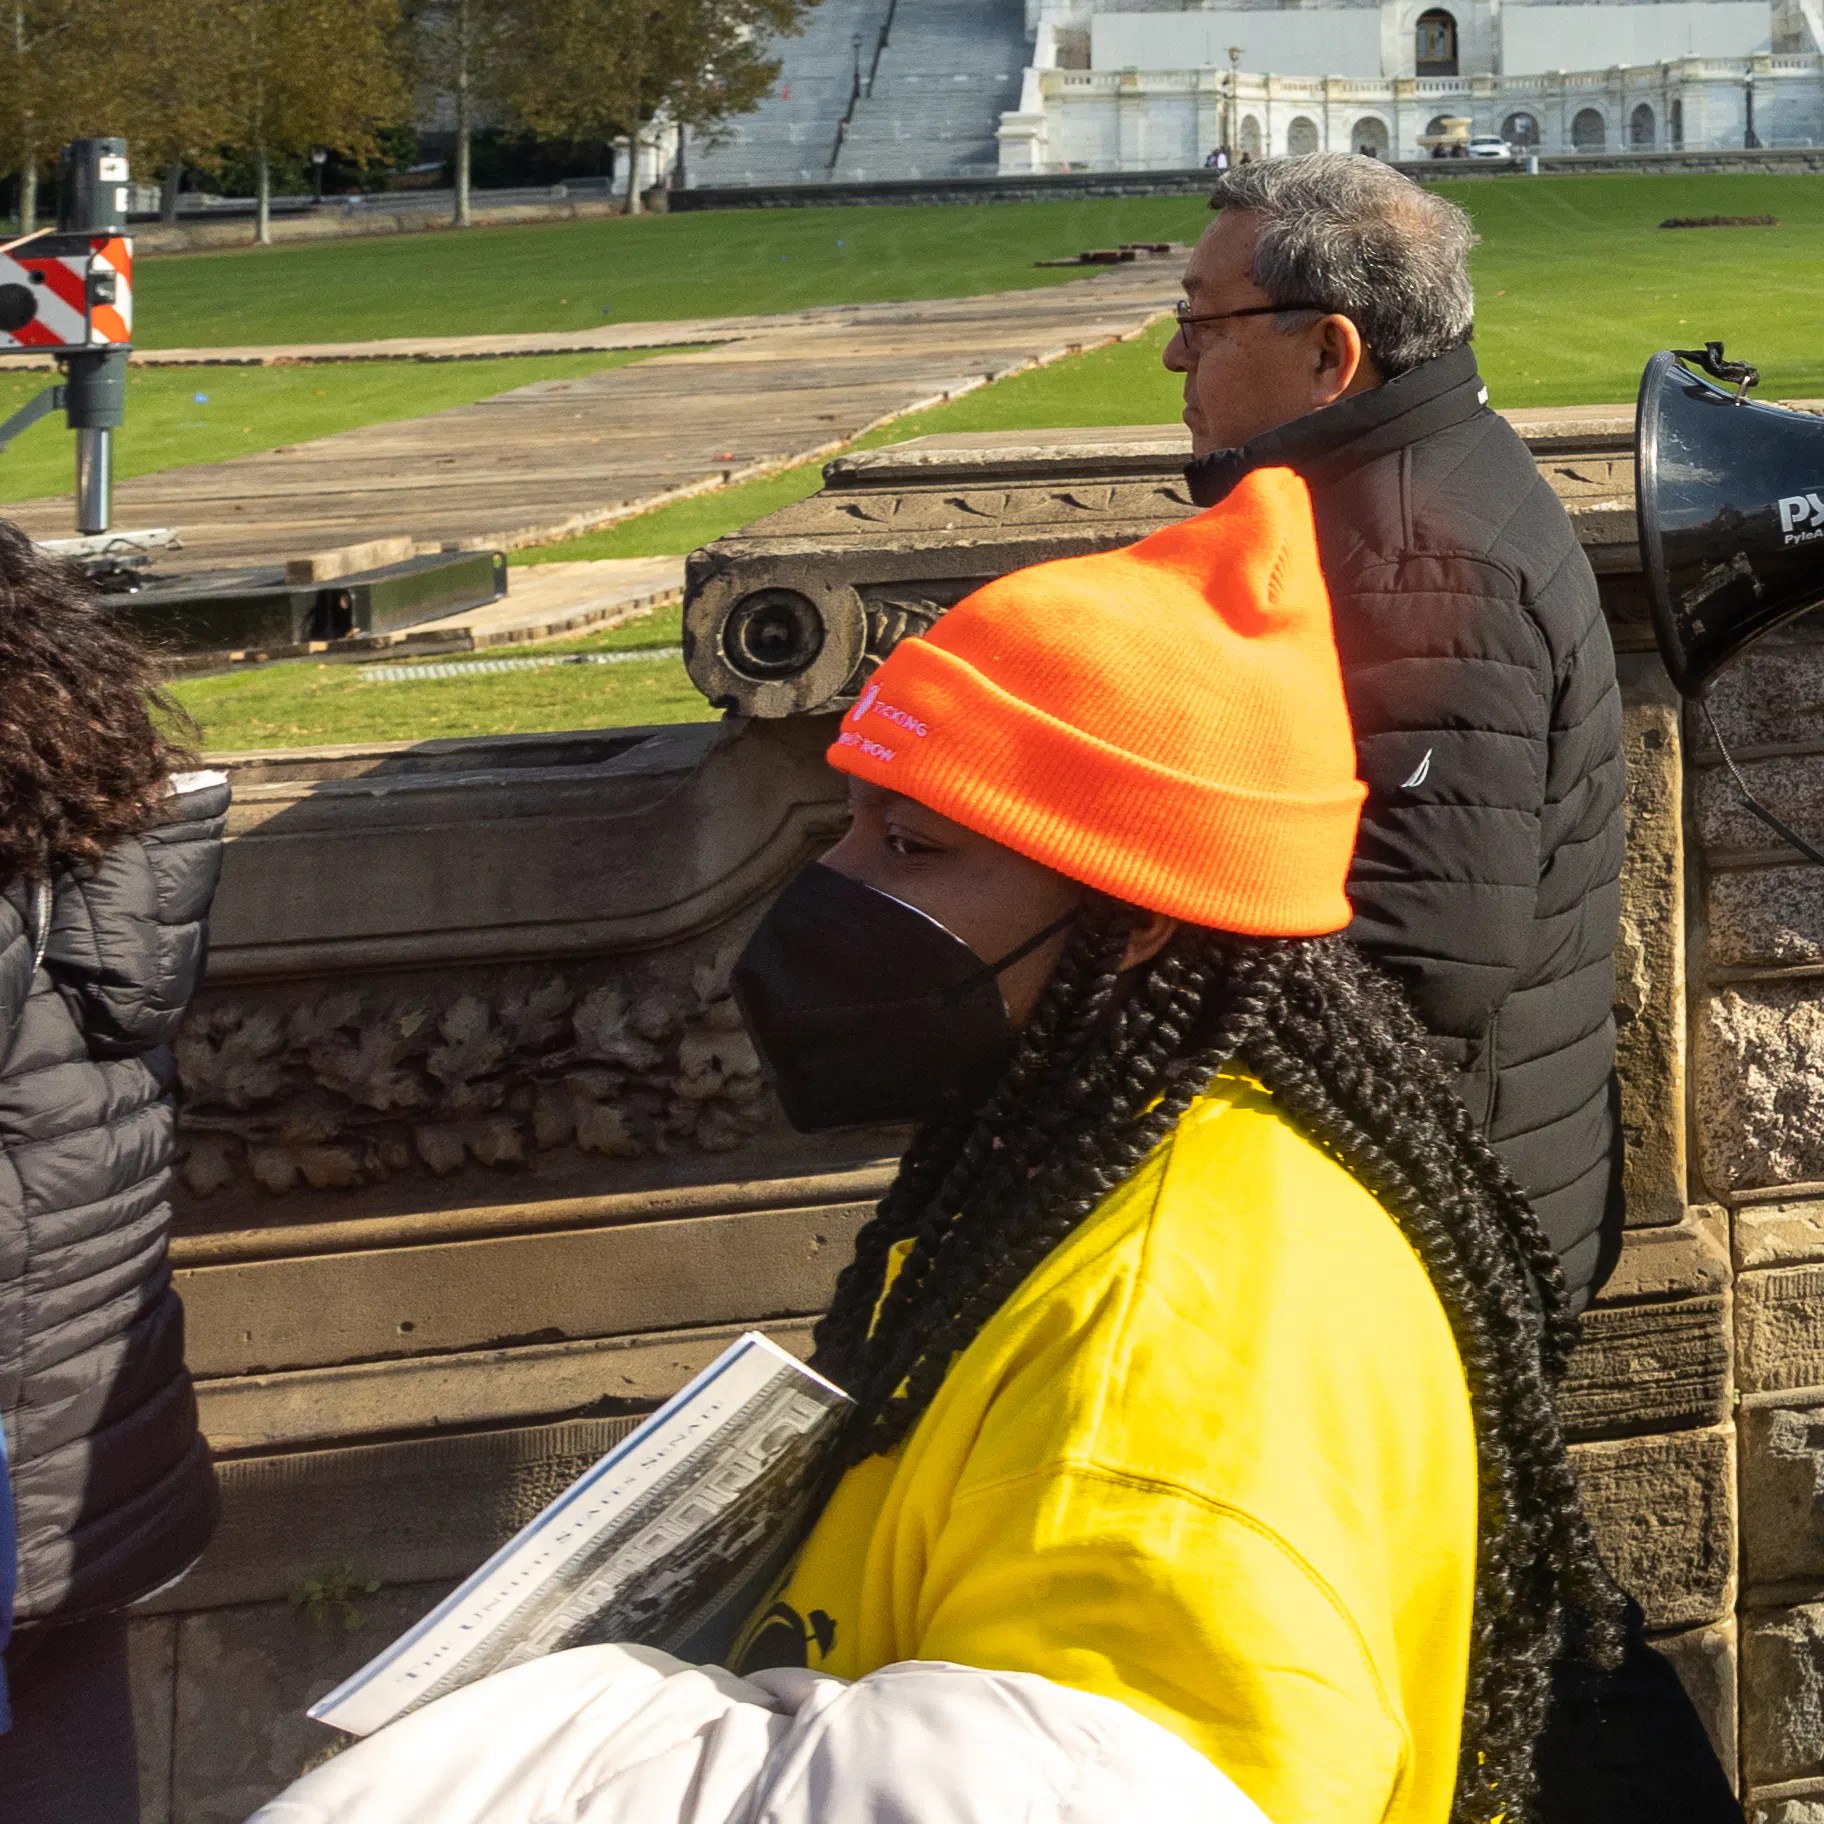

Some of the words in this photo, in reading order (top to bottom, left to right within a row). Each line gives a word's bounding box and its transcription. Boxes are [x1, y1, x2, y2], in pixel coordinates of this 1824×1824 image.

[401, 1644, 450, 1680] THE
[459, 1550, 551, 1632] UNITED
[555, 1477, 636, 1545] STATES
[640, 1402, 722, 1468] SENATE
